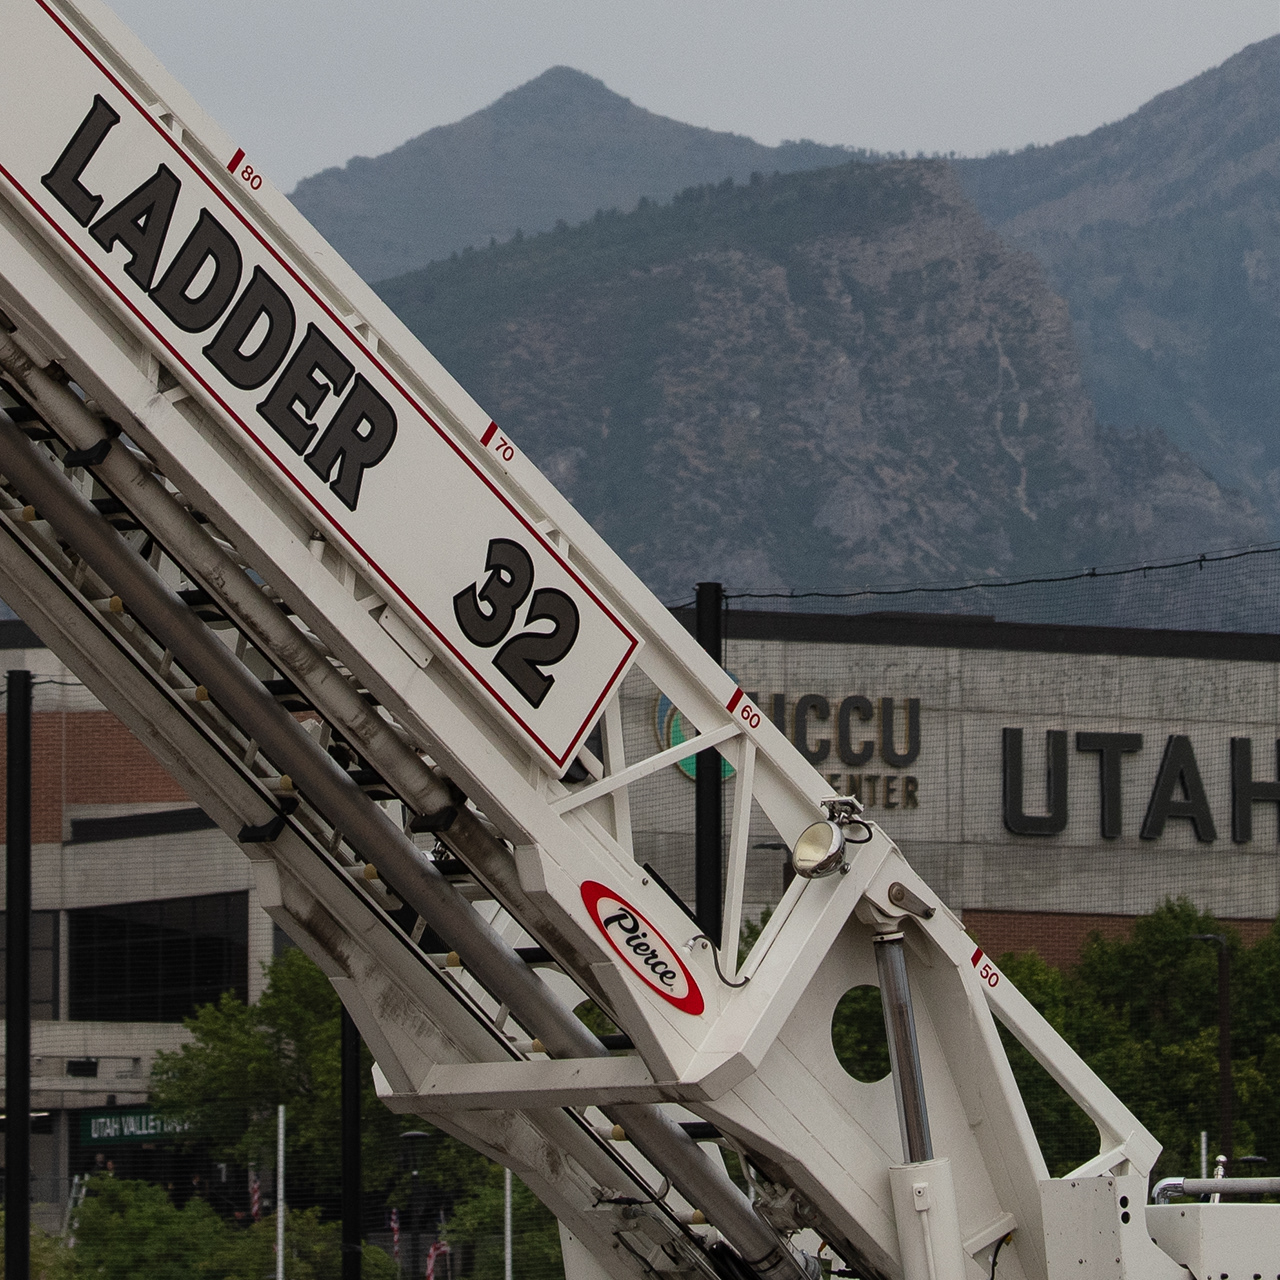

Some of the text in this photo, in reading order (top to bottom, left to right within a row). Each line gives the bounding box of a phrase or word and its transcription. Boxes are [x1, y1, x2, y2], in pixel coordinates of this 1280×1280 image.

[241, 164, 263, 190] 80
[41, 94, 398, 512] LADDER
[453, 538, 580, 709] 32
[495, 436, 515, 461] 70
[740, 704, 761, 729] 60
[826, 773, 919, 808] ENTER
[603, 907, 677, 987] Pierce
[980, 963, 999, 987] 50
[91, 1117, 120, 1138] UTAH
